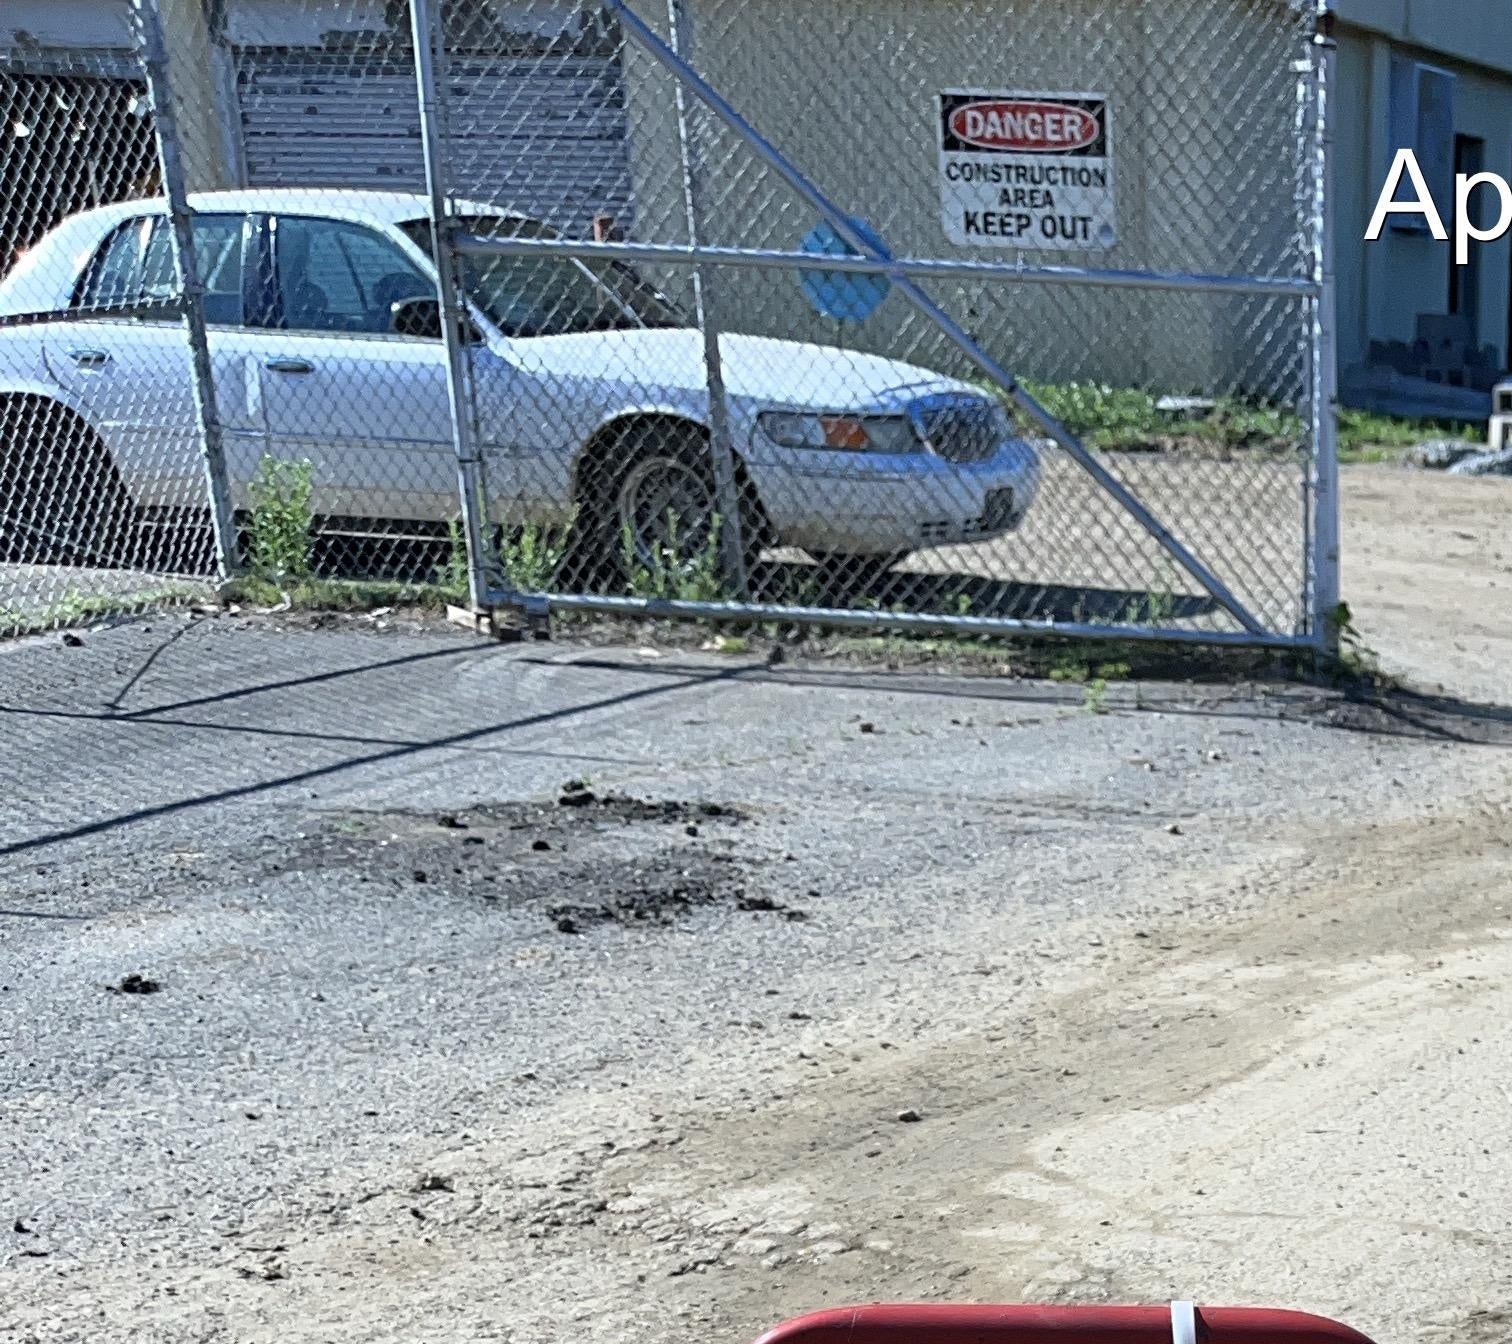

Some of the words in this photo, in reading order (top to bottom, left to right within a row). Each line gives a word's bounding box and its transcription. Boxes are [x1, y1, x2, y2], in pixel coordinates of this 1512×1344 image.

[965, 110, 1082, 142] DANGER
[946, 162, 1106, 187] CONSTRUCTION
[999, 187, 1055, 208] AREA
[963, 211, 1031, 237] KEEP
[1041, 215, 1093, 240] OUT
